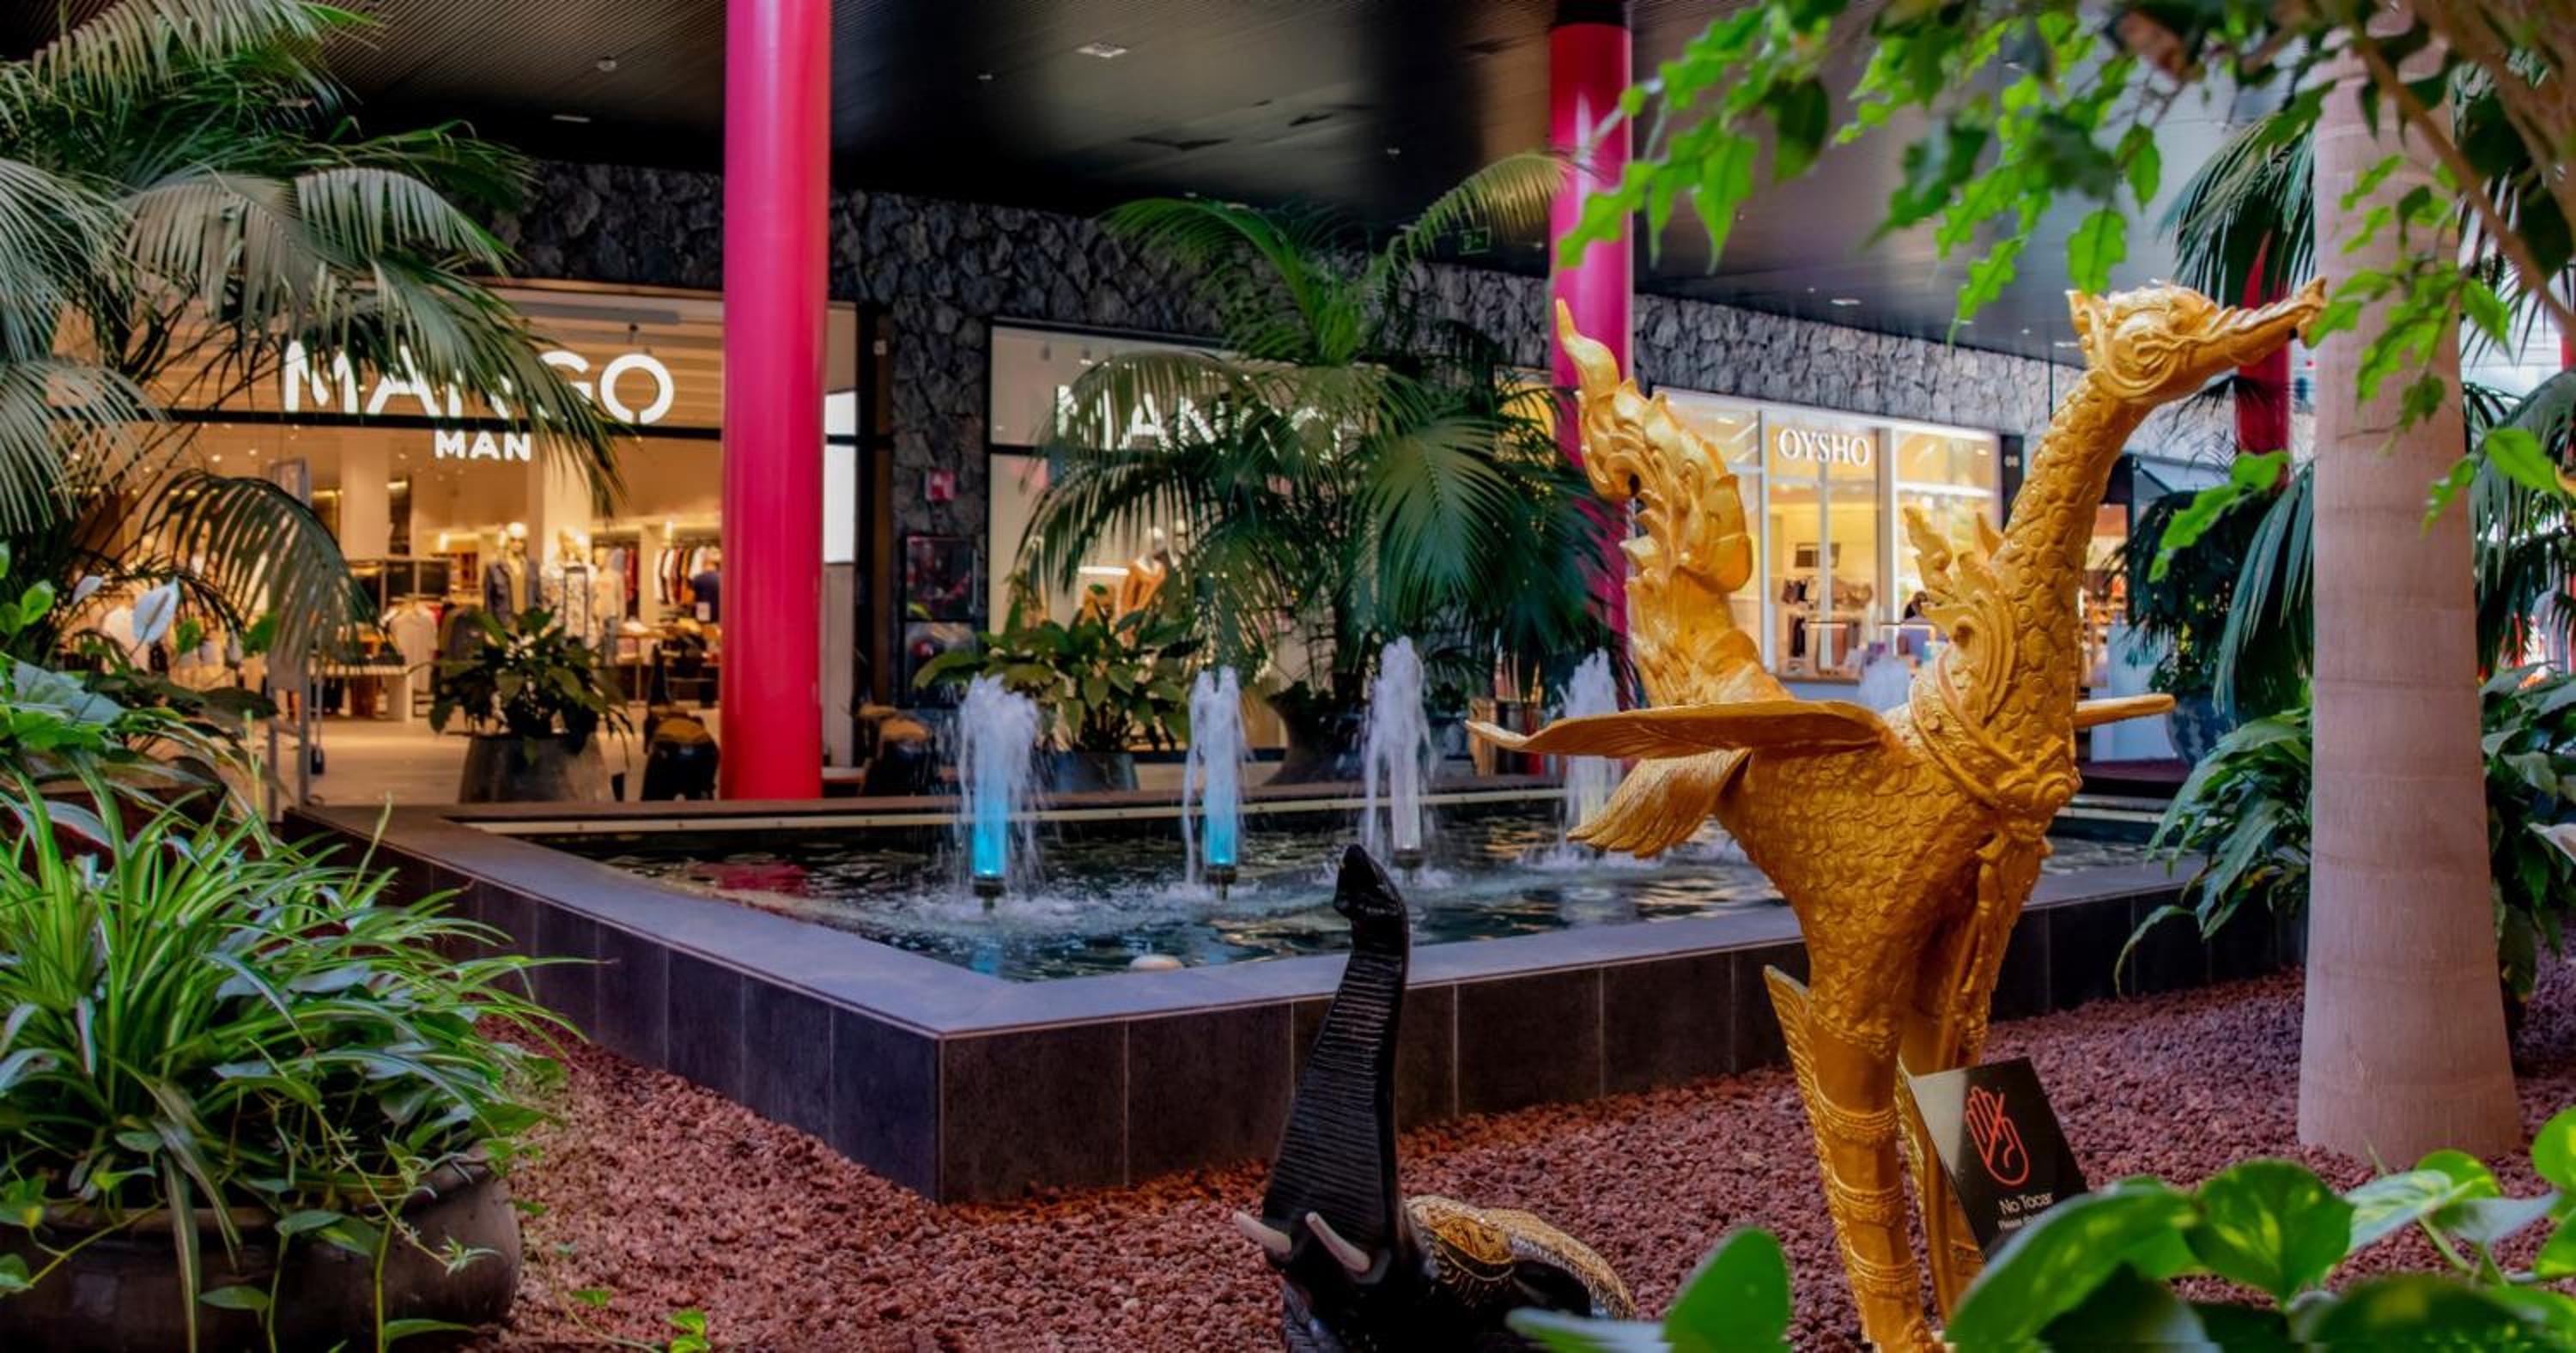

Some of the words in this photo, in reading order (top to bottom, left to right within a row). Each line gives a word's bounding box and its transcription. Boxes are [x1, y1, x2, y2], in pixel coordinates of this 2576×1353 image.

[1057, 384, 1343, 467] MAN
[434, 430, 532, 461] MAN
[1778, 428, 1870, 467] OYSHO
[1998, 1198, 2020, 1215] No
[2018, 1192, 2053, 1210] Tocar
